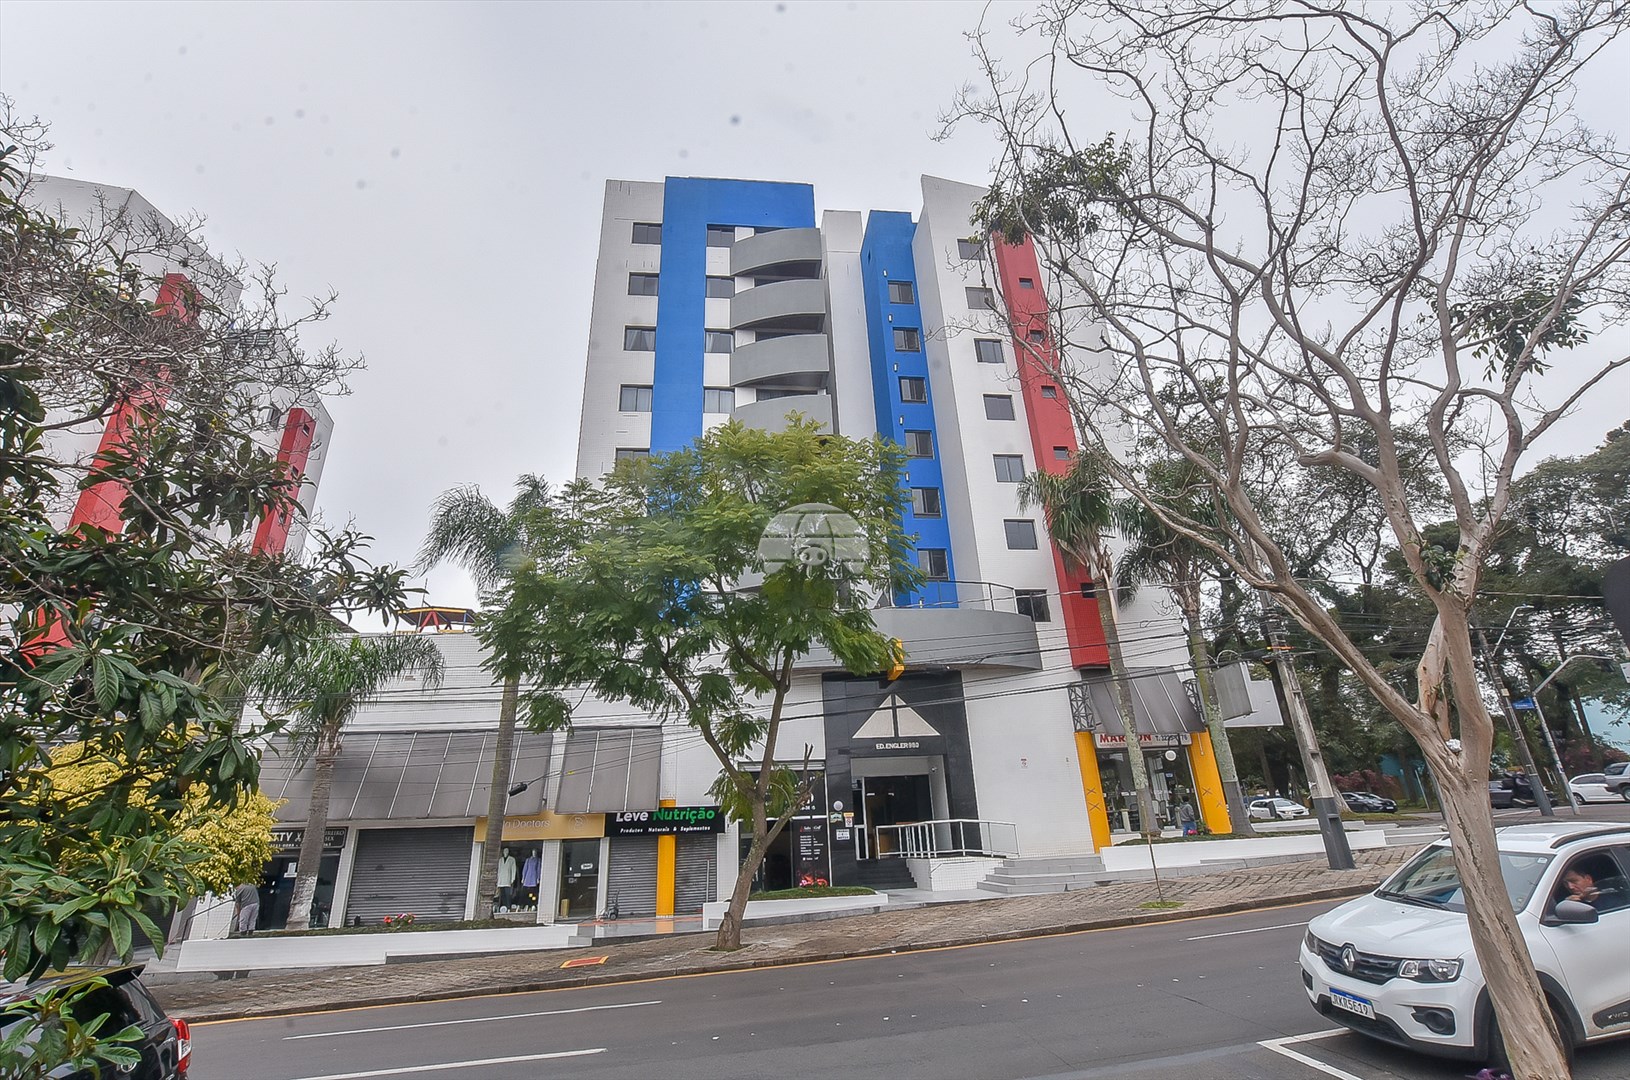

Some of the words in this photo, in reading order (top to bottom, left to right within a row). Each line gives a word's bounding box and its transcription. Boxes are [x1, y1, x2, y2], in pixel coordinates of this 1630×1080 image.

[616, 811, 649, 822] Leve
[652, 807, 715, 824] Nutrição
[512, 819, 551, 829] Doctors
